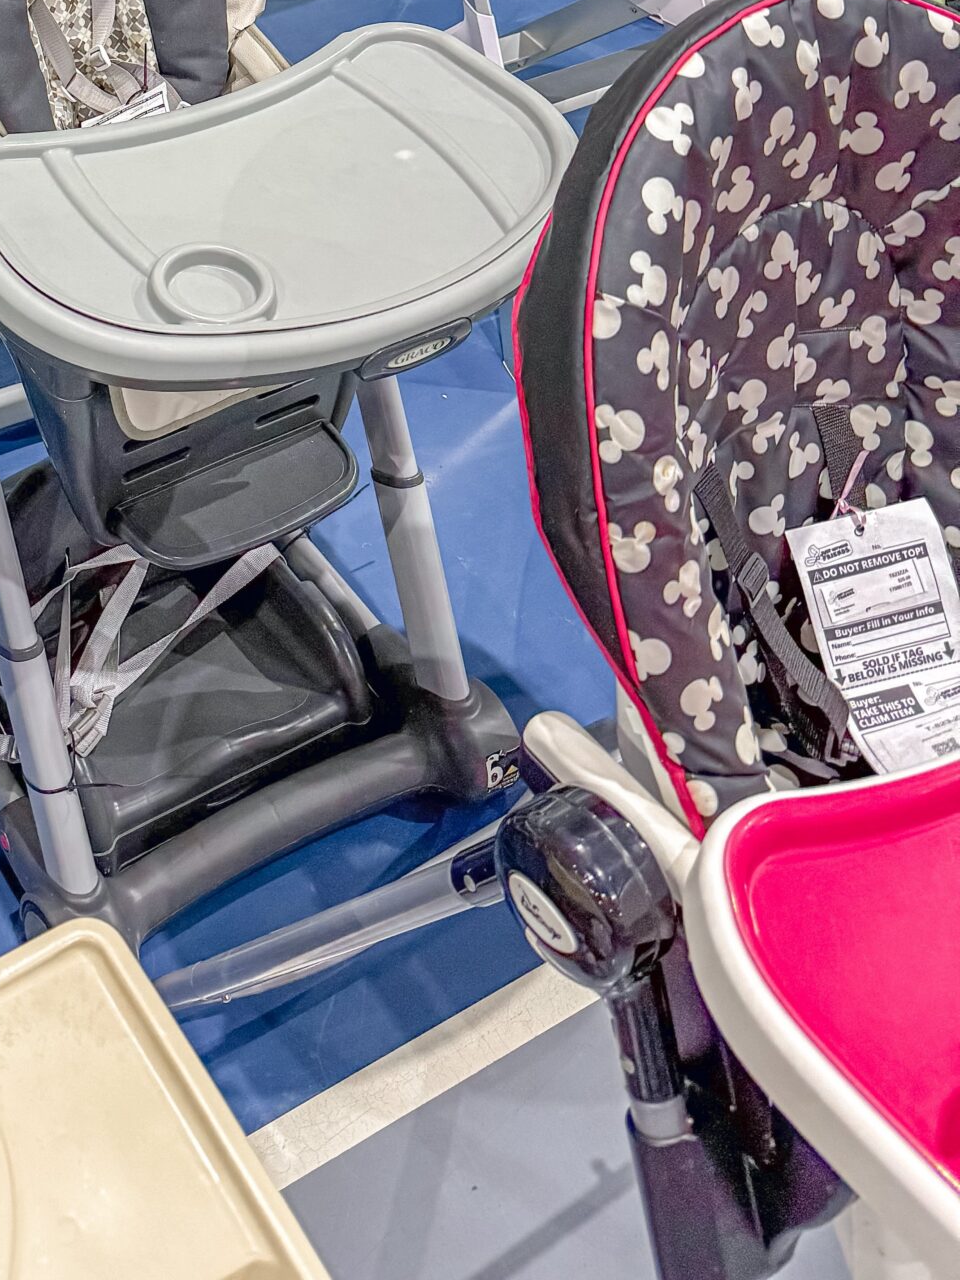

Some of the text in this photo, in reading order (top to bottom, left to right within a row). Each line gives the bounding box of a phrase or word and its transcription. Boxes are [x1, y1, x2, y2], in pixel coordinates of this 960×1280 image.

[394, 340, 445, 365] GRACO
[820, 547, 851, 561] FRIENDS
[821, 545, 925, 578] DO NOT REMOVE TOP!
[834, 605, 935, 638] Buyer: Fill in Your Info
[830, 640, 852, 649] Name:
[834, 652, 856, 661] Phone:
[846, 651, 943, 682] BELOW IS MISSING
[861, 646, 924, 669] SOLD IF TAG
[850, 695, 882, 709] Buyer:
[853, 697, 915, 719] TAKE THIS TO
[858, 707, 915, 728] CLAIM ITEM
